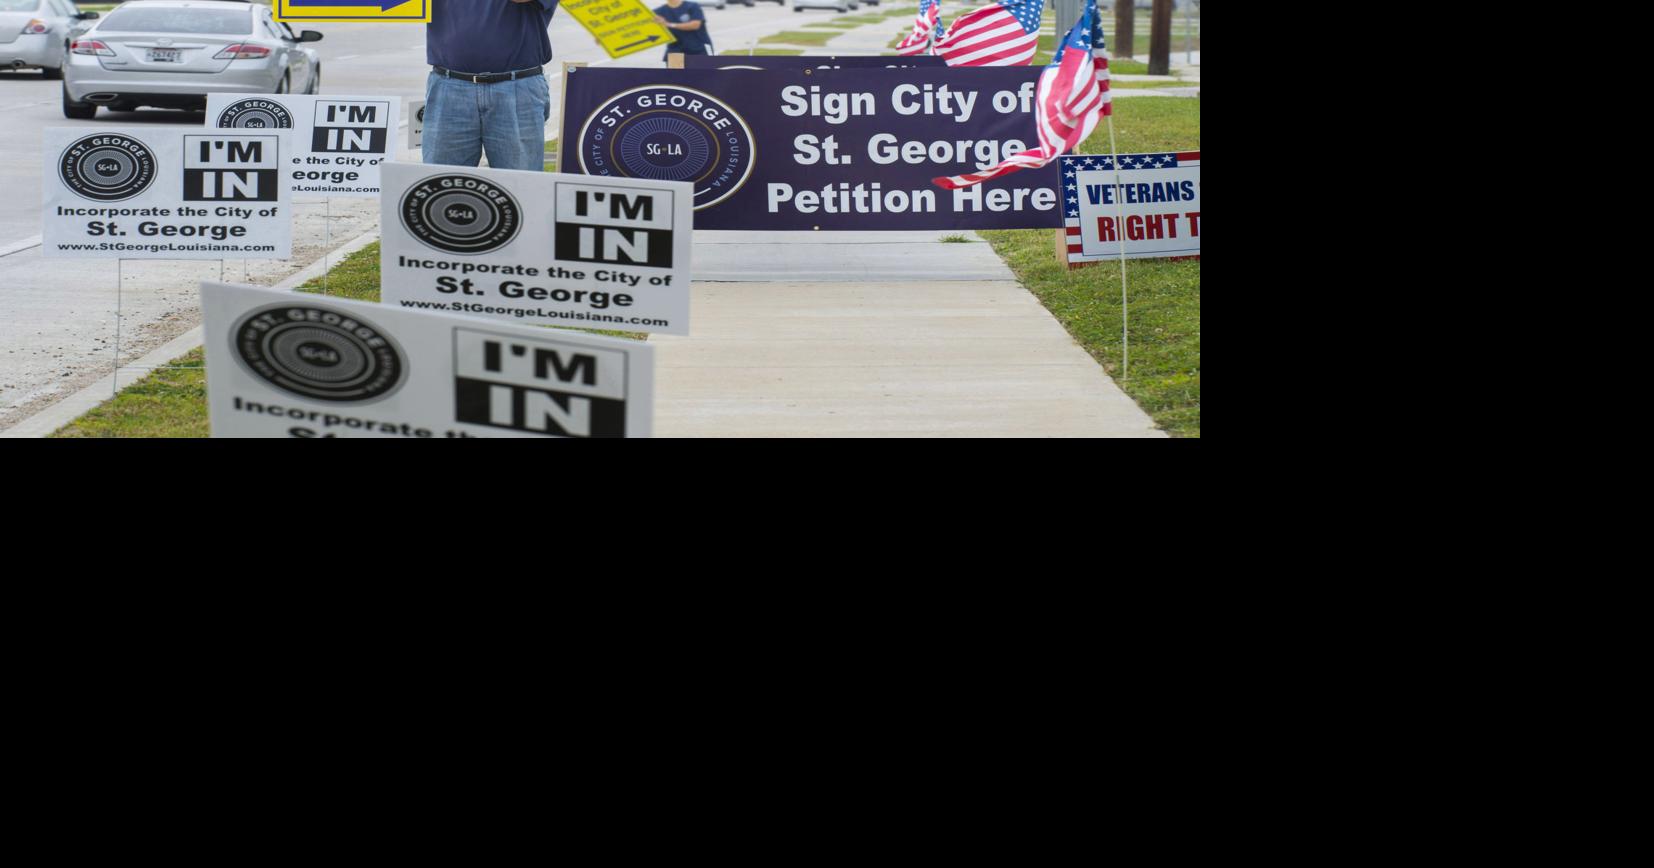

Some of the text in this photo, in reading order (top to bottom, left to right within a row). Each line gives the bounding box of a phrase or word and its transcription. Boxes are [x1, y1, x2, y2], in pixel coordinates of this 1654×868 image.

[244, 101, 286, 118] GEORGE
[326, 105, 377, 123] I'M
[601, 93, 732, 131] ST. GEORGE
[781, 81, 1035, 124] Sign City of
[71, 137, 146, 158] ST. GEORGE
[200, 140, 262, 163] I'M
[326, 128, 372, 151] IN
[793, 133, 1027, 171] St. George
[306, 156, 330, 165] the
[335, 157, 365, 167] City
[592, 144, 604, 167] CITY
[712, 131, 740, 187] LOUISIANA
[203, 171, 259, 198] IN
[291, 185, 380, 193] eLouisiana.com
[292, 170, 359, 184] eorge
[415, 178, 508, 205] ST. GEORGE
[767, 181, 1057, 214] Petition Here
[1086, 180, 1195, 205] VETERANS
[57, 206, 278, 219] Incorporate the City of
[575, 190, 653, 221] I'M
[87, 221, 247, 241] St. George
[1097, 212, 1179, 242] RIGHT
[57, 242, 275, 253] www.StGeorgeLouisiana.com
[578, 226, 649, 264] IN
[398, 256, 673, 287] Incorporate the City of
[436, 276, 634, 309] St. George
[400, 300, 669, 327] www.StGeorgeLouisiana.com
[286, 308, 386, 349] GEORGE
[484, 340, 596, 386] I'M
[233, 397, 432, 438] Incorporate
[489, 384, 591, 437] IN
